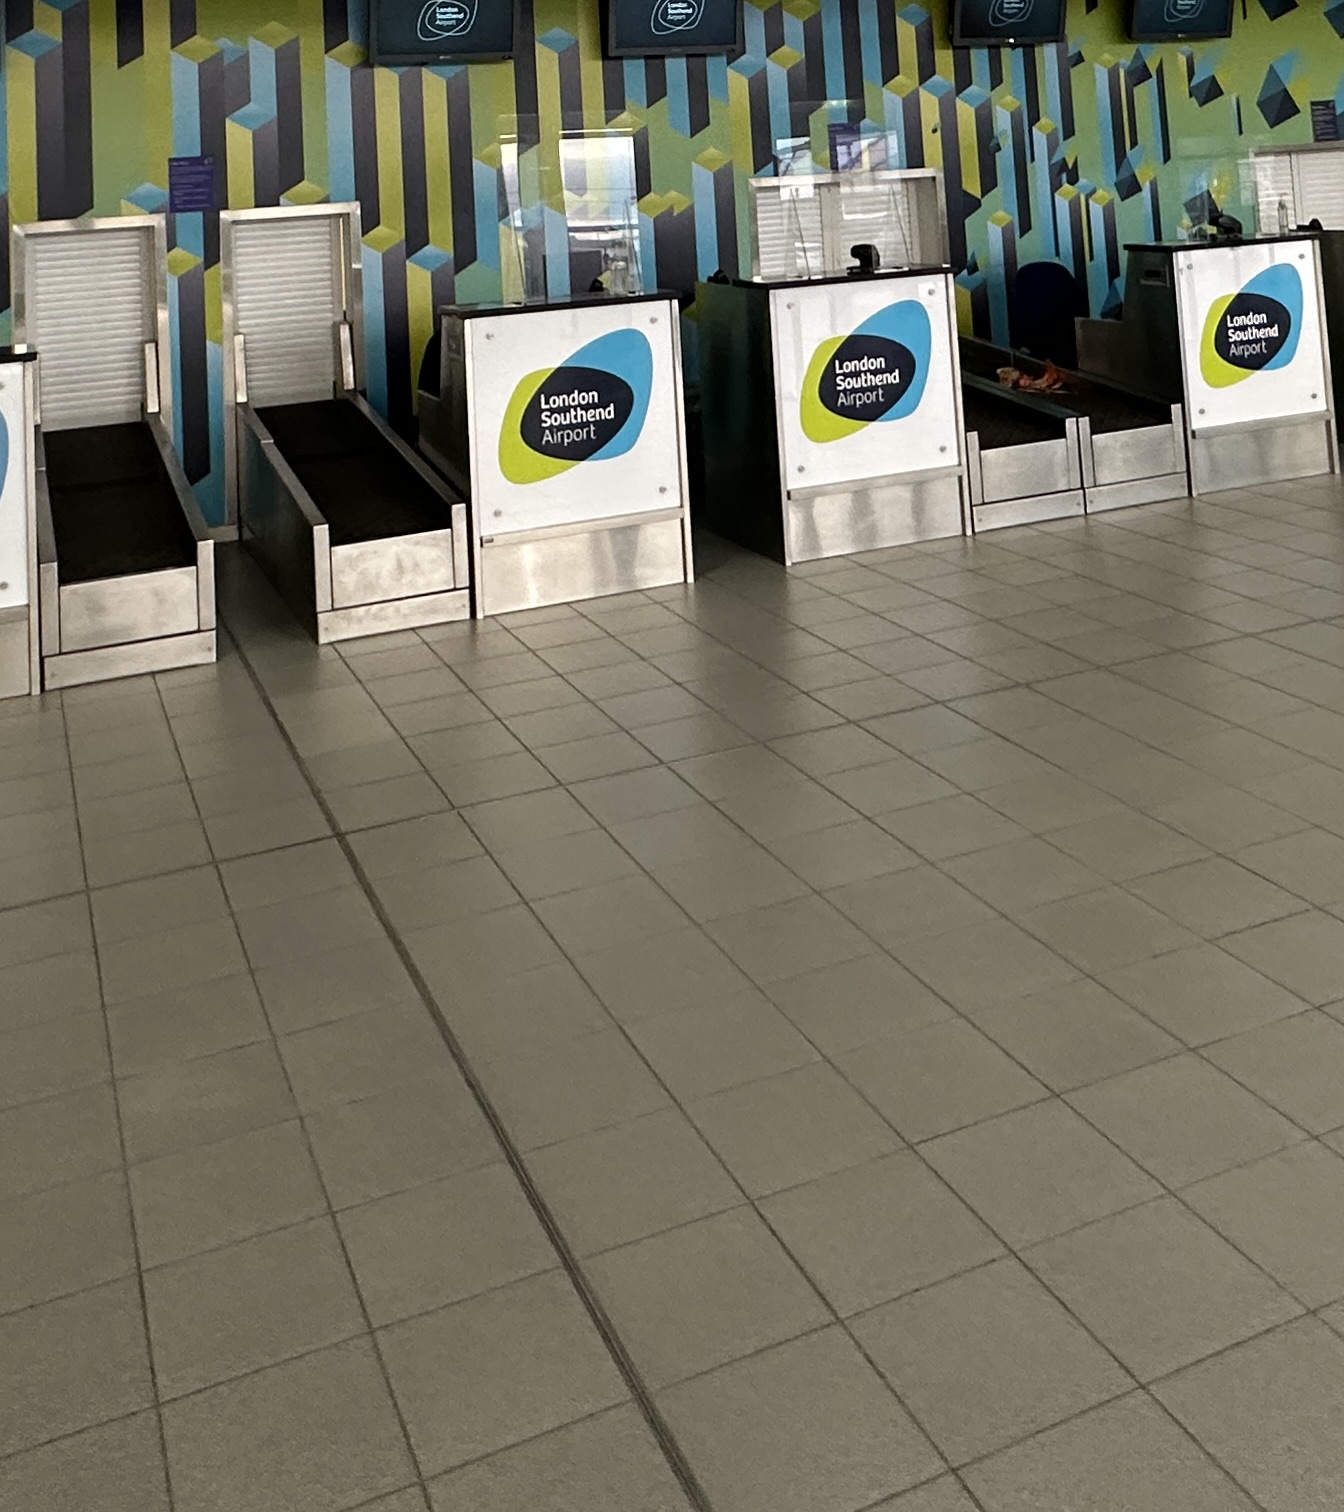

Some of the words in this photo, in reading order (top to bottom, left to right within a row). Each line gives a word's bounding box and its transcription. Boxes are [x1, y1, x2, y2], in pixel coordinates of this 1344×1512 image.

[1226, 311, 1268, 328] London
[1227, 324, 1279, 343] Southend
[1229, 340, 1268, 359] Airport
[834, 355, 886, 374] London
[835, 369, 900, 390] Southend
[540, 389, 599, 410] London
[836, 387, 885, 408] Airport
[540, 403, 615, 428] Southend
[541, 423, 597, 446] Airport
